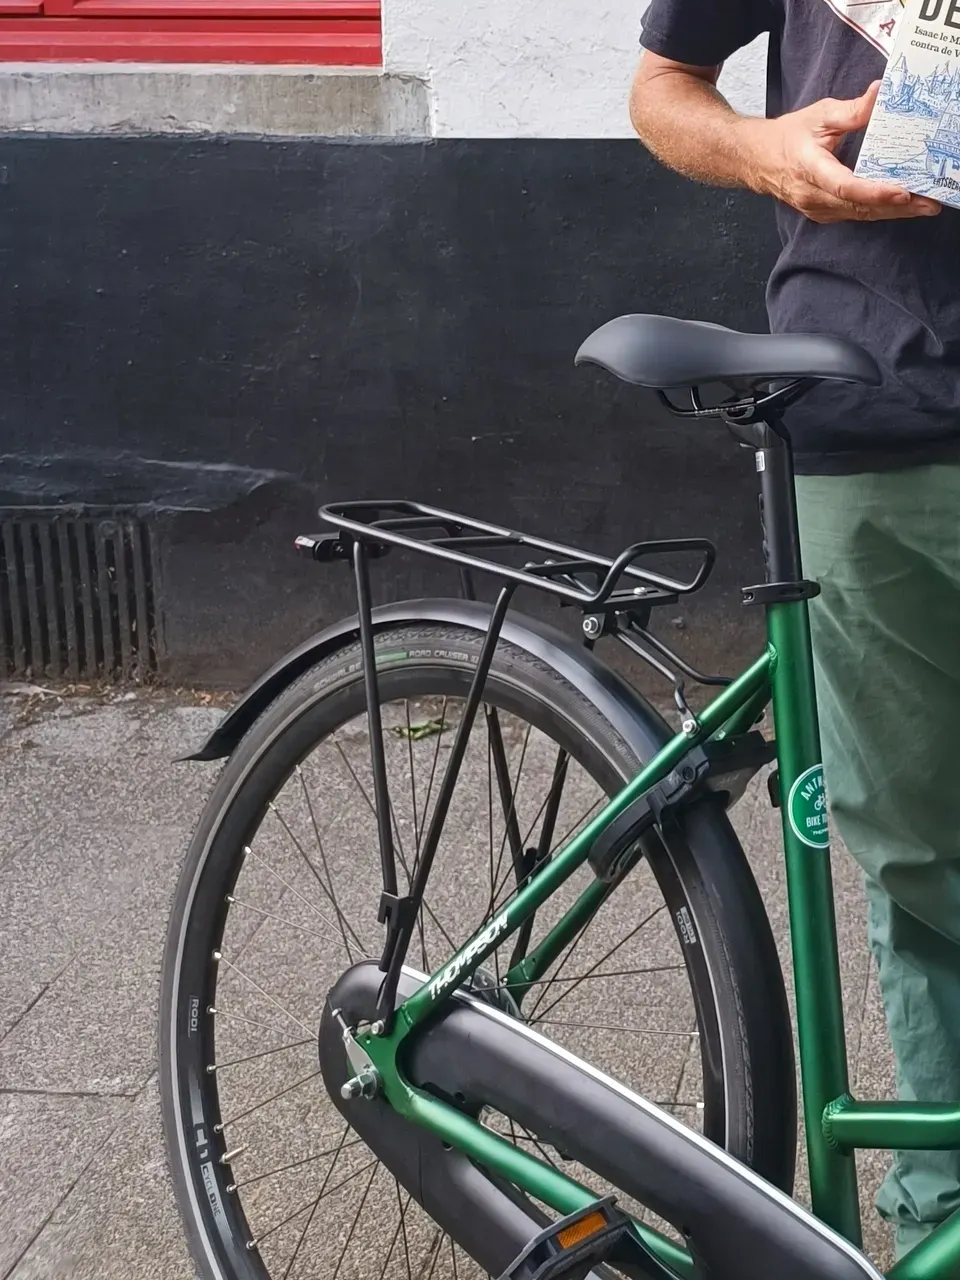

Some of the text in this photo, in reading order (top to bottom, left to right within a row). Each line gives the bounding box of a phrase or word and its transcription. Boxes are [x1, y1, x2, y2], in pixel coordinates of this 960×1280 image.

[914, 25, 939, 40] Isaac
[939, 32, 949, 42] le
[910, 38, 939, 53] contra
[940, 46, 953, 57] de
[806, 814, 821, 828] BIKE
[675, 911, 690, 944] RODI
[428, 910, 509, 1001] THOMPSON
[190, 997, 199, 1033] RODI
